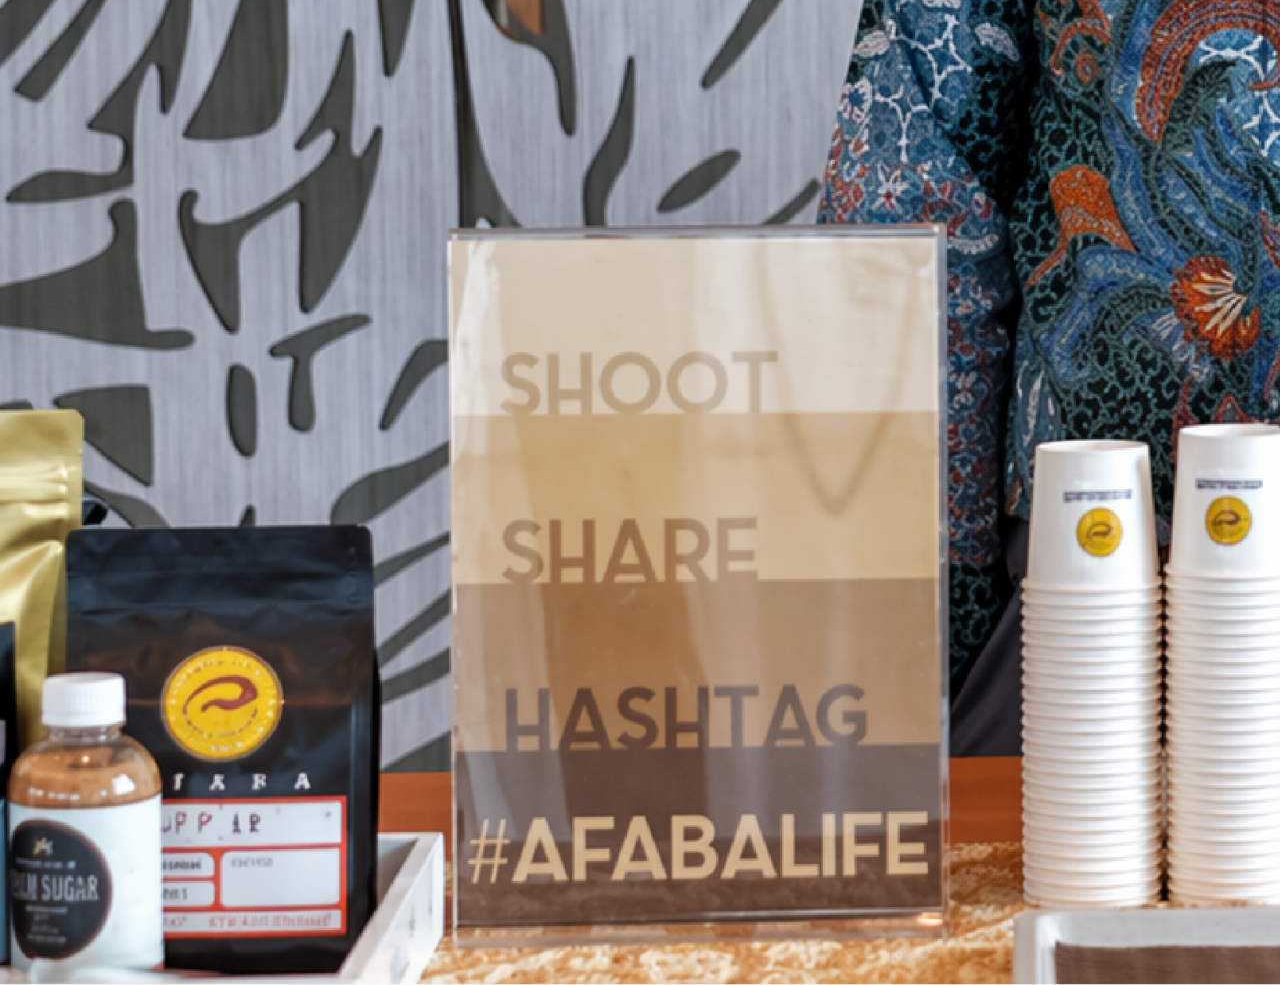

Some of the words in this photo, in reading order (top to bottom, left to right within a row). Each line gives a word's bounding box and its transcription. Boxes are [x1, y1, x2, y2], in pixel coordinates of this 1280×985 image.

[499, 351, 779, 416] SHOOT
[501, 518, 760, 586] SHARE
[505, 684, 869, 753] HASHTAG
[172, 771, 312, 792] TARA
[467, 811, 931, 885] #AFABALIFE
[40, 873, 100, 902] SUGAR
